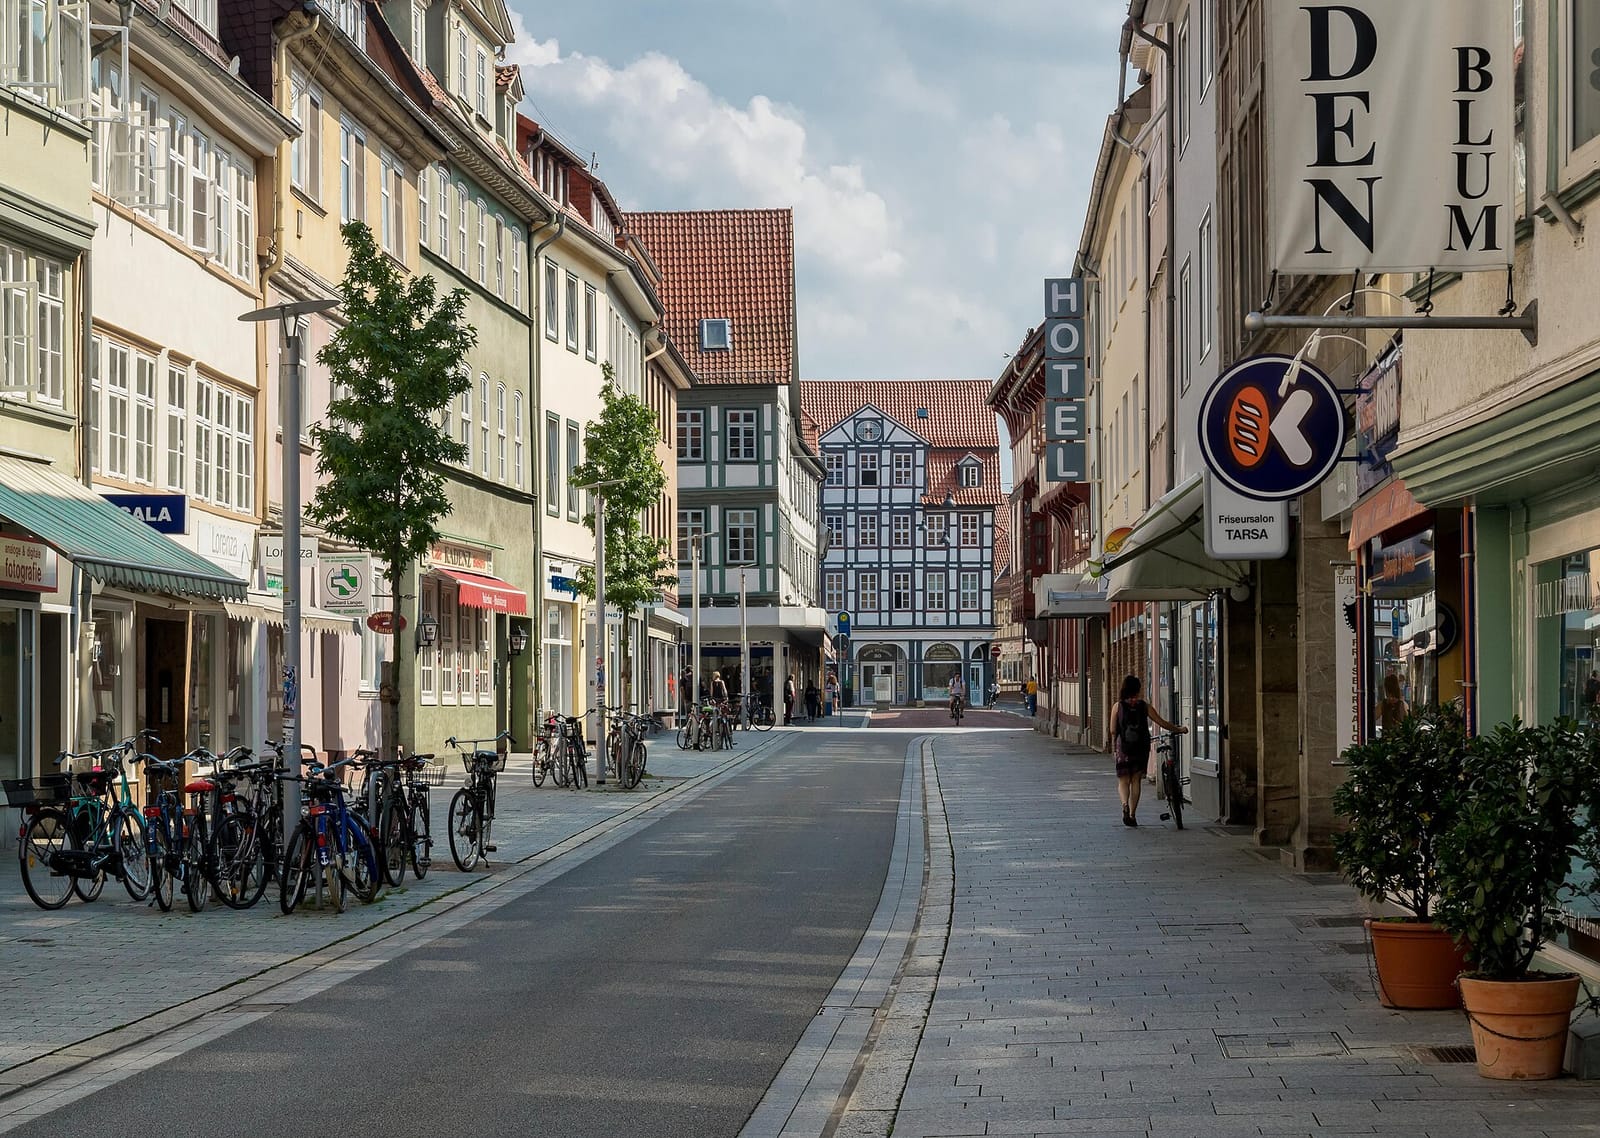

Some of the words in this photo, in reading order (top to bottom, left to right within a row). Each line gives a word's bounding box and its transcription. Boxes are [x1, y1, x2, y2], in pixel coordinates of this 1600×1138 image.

[1443, 46, 1503, 252] BLUM
[1050, 281, 1080, 478] HOTEL
[1218, 515, 1275, 524] Friseursalon
[211, 525, 239, 557] Lorenza
[1225, 528, 1268, 541] TARSA
[265, 545, 313, 558] Lorza
[5, 557, 42, 584] fotografie
